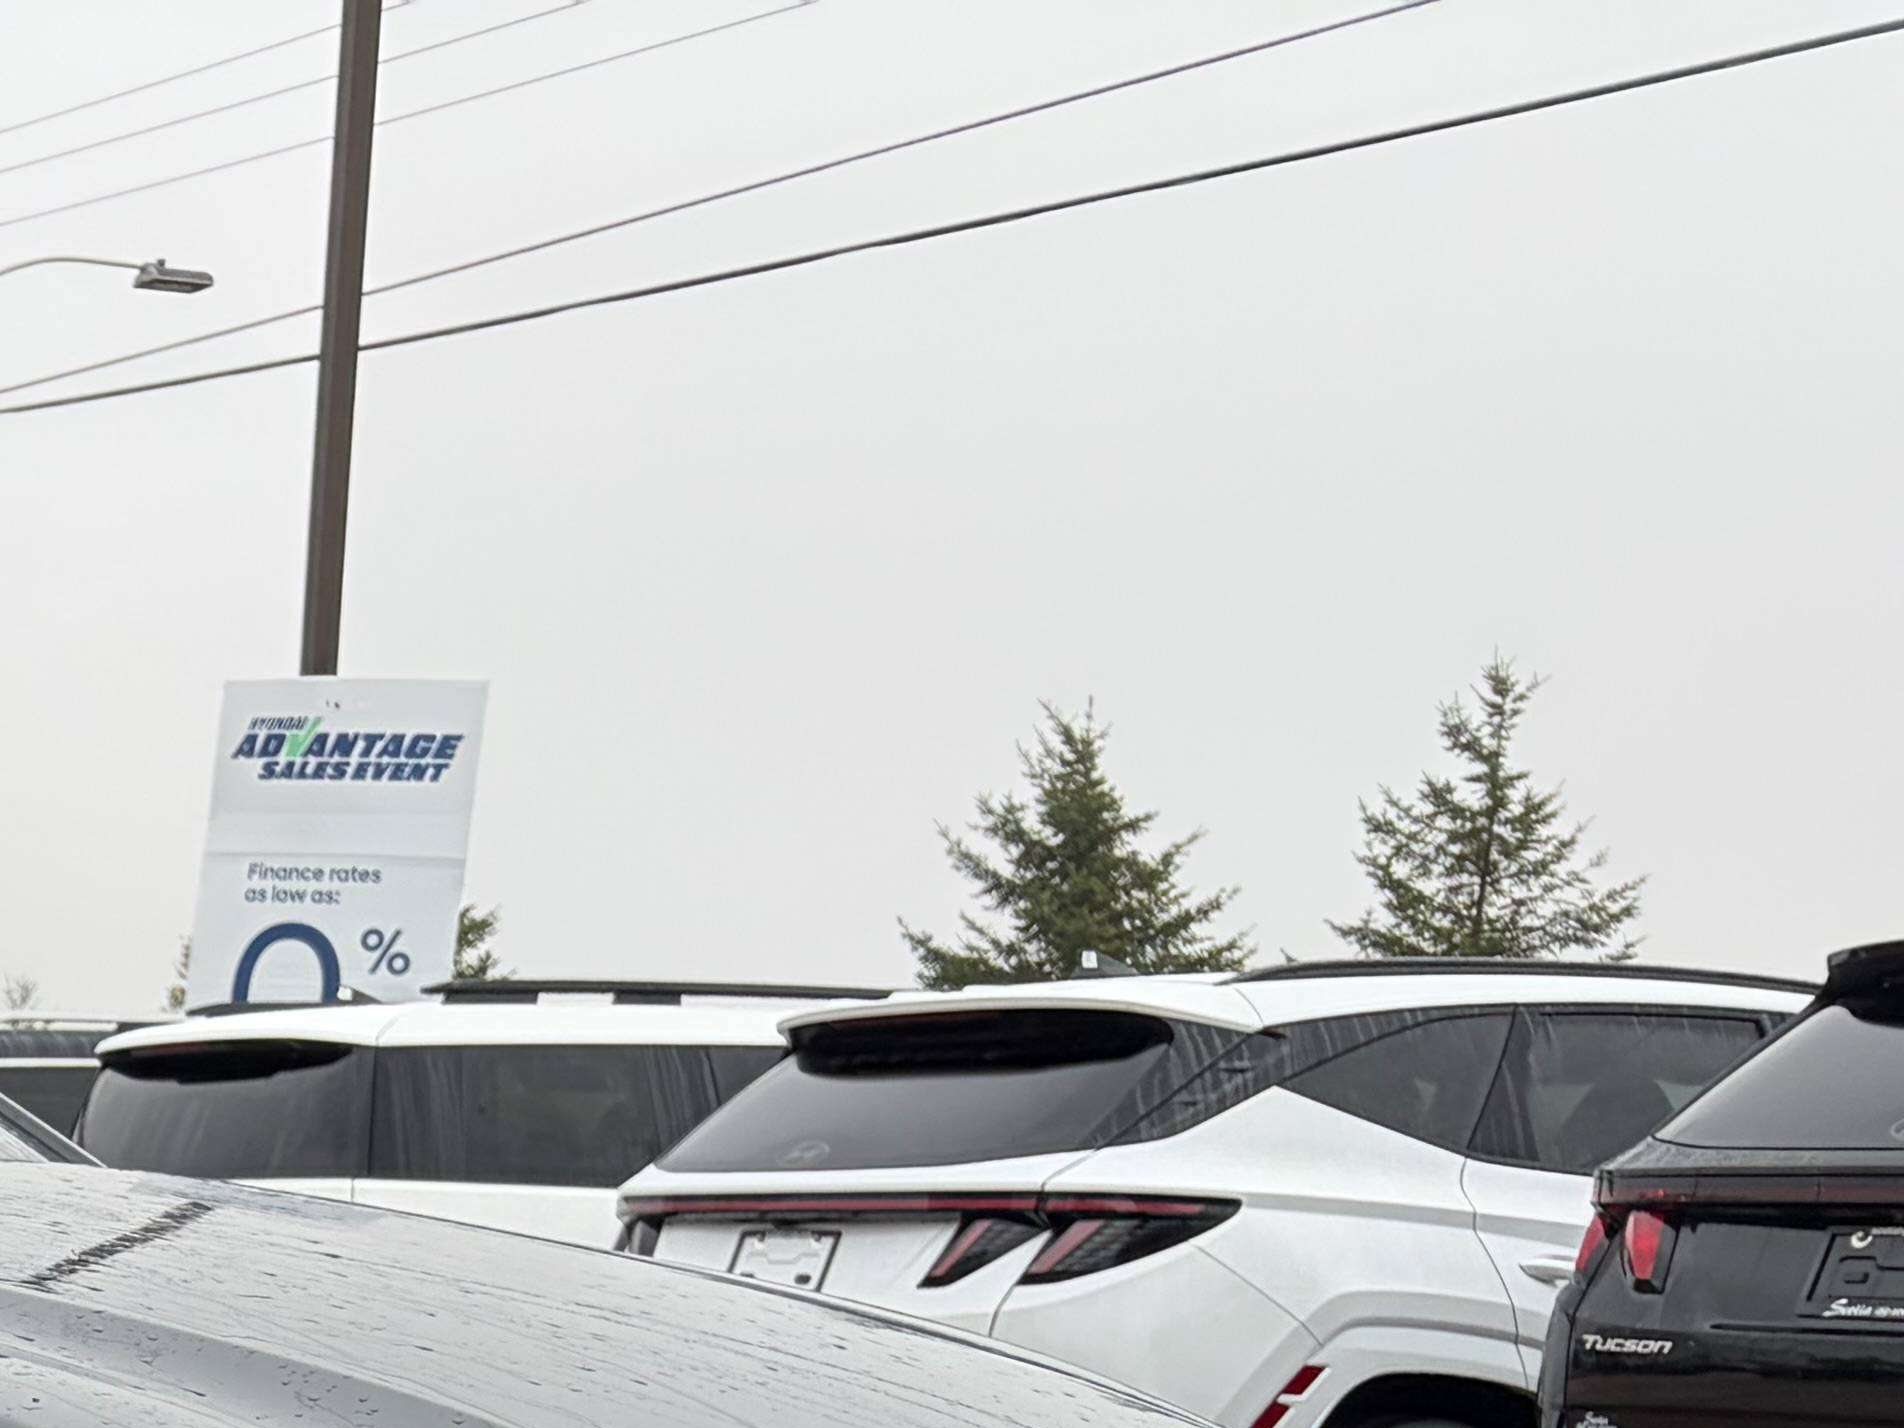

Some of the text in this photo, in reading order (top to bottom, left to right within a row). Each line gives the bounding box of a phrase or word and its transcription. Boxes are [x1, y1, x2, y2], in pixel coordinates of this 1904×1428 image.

[232, 730, 465, 759] ADVANTAGE
[257, 760, 451, 783] SALES EVENT
[247, 861, 383, 884] Finance rates
[244, 884, 341, 905] as low as:
[1582, 1333, 1673, 1355] TUCSON
